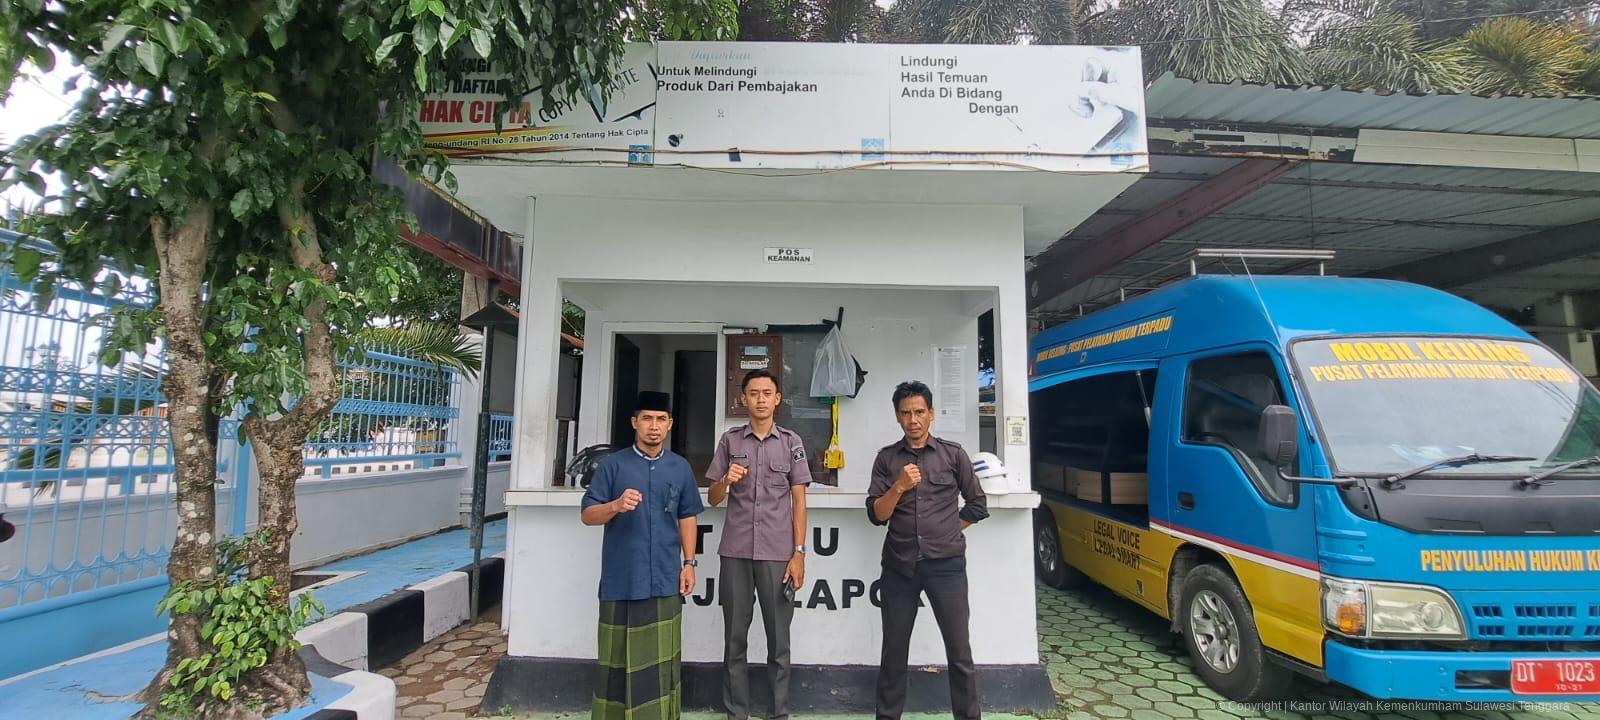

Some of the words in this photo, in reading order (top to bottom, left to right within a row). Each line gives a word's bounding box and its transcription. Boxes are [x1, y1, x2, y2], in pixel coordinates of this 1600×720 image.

[900, 55, 958, 67] Lindungi
[657, 66, 690, 76] Untuk
[694, 66, 757, 78] Melindungi
[901, 72, 933, 83] Hasil
[938, 72, 988, 83] Temuan
[657, 80, 703, 91] Produk
[708, 80, 734, 91] Dari
[738, 80, 818, 94] Pembajakan
[901, 87, 935, 98] Anda
[939, 87, 953, 98] Di
[957, 88, 1003, 101] Bidang
[419, 100, 465, 123] HAK
[969, 102, 1019, 115] Dengan
[492, 137, 506, 145] No.
[509, 136, 519, 144] 28
[549, 133, 569, 141] 2014
[572, 131, 606, 139] Tentang
[608, 129, 625, 137] Hak
[627, 128, 649, 136] Cipta
[1137, 315, 1173, 337] TERPADU
[1328, 342, 1421, 362] MOBIL
[1416, 342, 1532, 363] KELILING
[1309, 366, 1364, 382] PUSAT
[1362, 363, 1452, 380] PELAYANAN
[1448, 364, 1508, 380] HUKUM
[1093, 519, 1115, 541] LEGAL
[1117, 527, 1140, 550] VOICE
[1421, 550, 1527, 571] PENYULUHAN
[1529, 550, 1584, 571] HUKUM
[1516, 662, 1536, 682] DT
[1556, 662, 1596, 682] 1023
